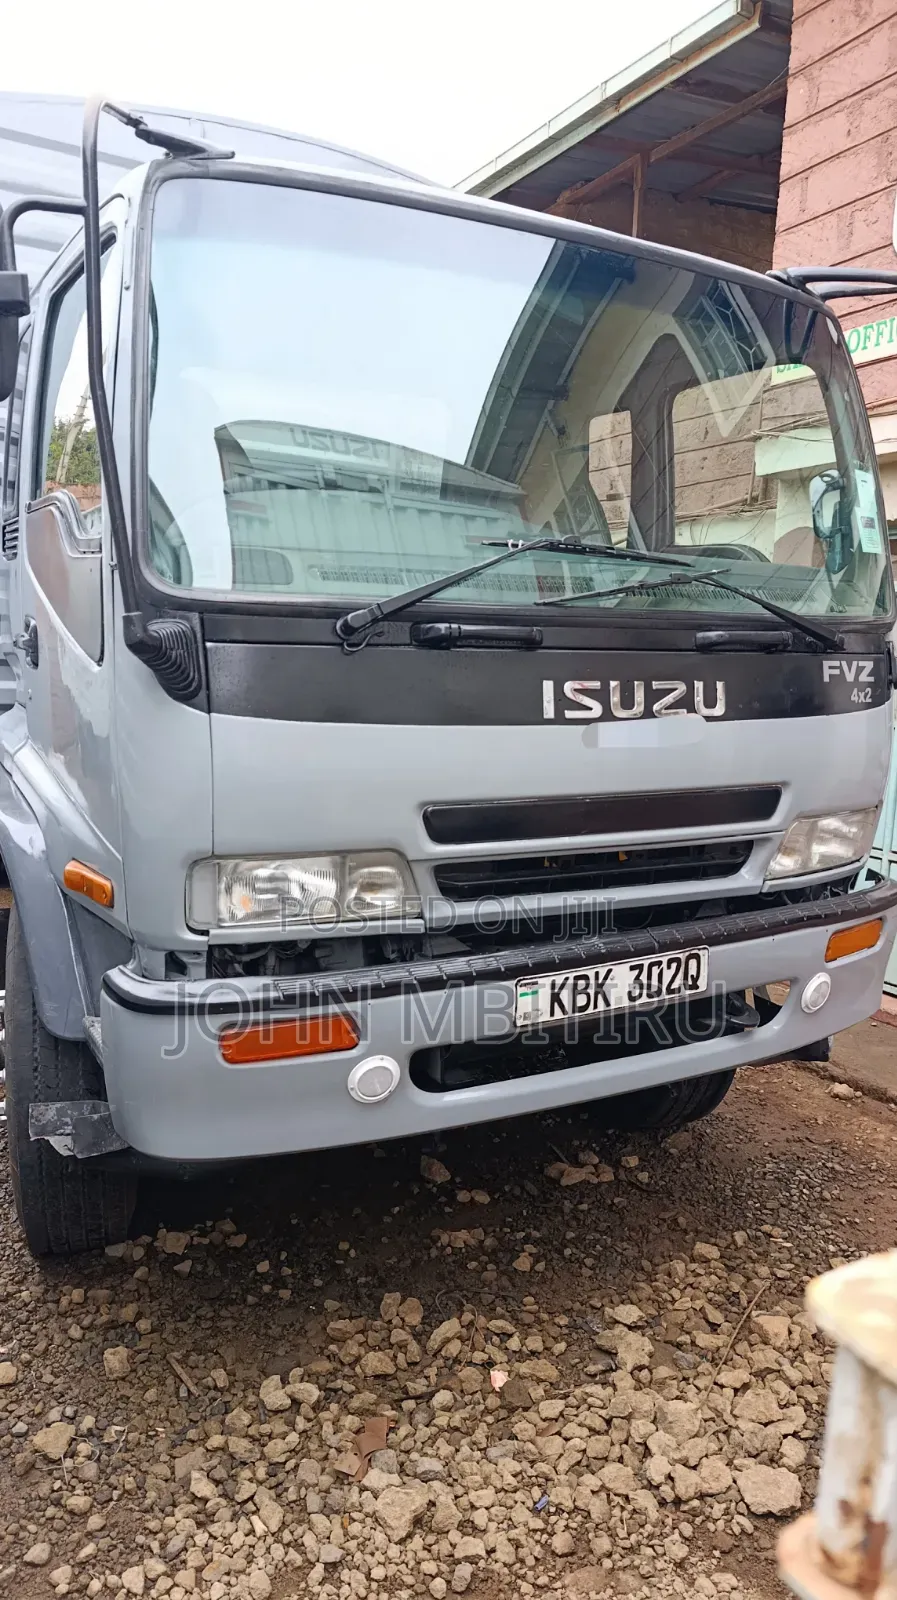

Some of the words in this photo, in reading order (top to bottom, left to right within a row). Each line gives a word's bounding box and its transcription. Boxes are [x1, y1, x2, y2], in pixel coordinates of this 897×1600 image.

[847, 317, 897, 353] OFFI
[822, 660, 875, 683] FVZ
[542, 679, 726, 719] ISUZU
[850, 687, 873, 704] 4x2
[549, 968, 613, 1018] KBK
[627, 952, 702, 1003] 302Q
